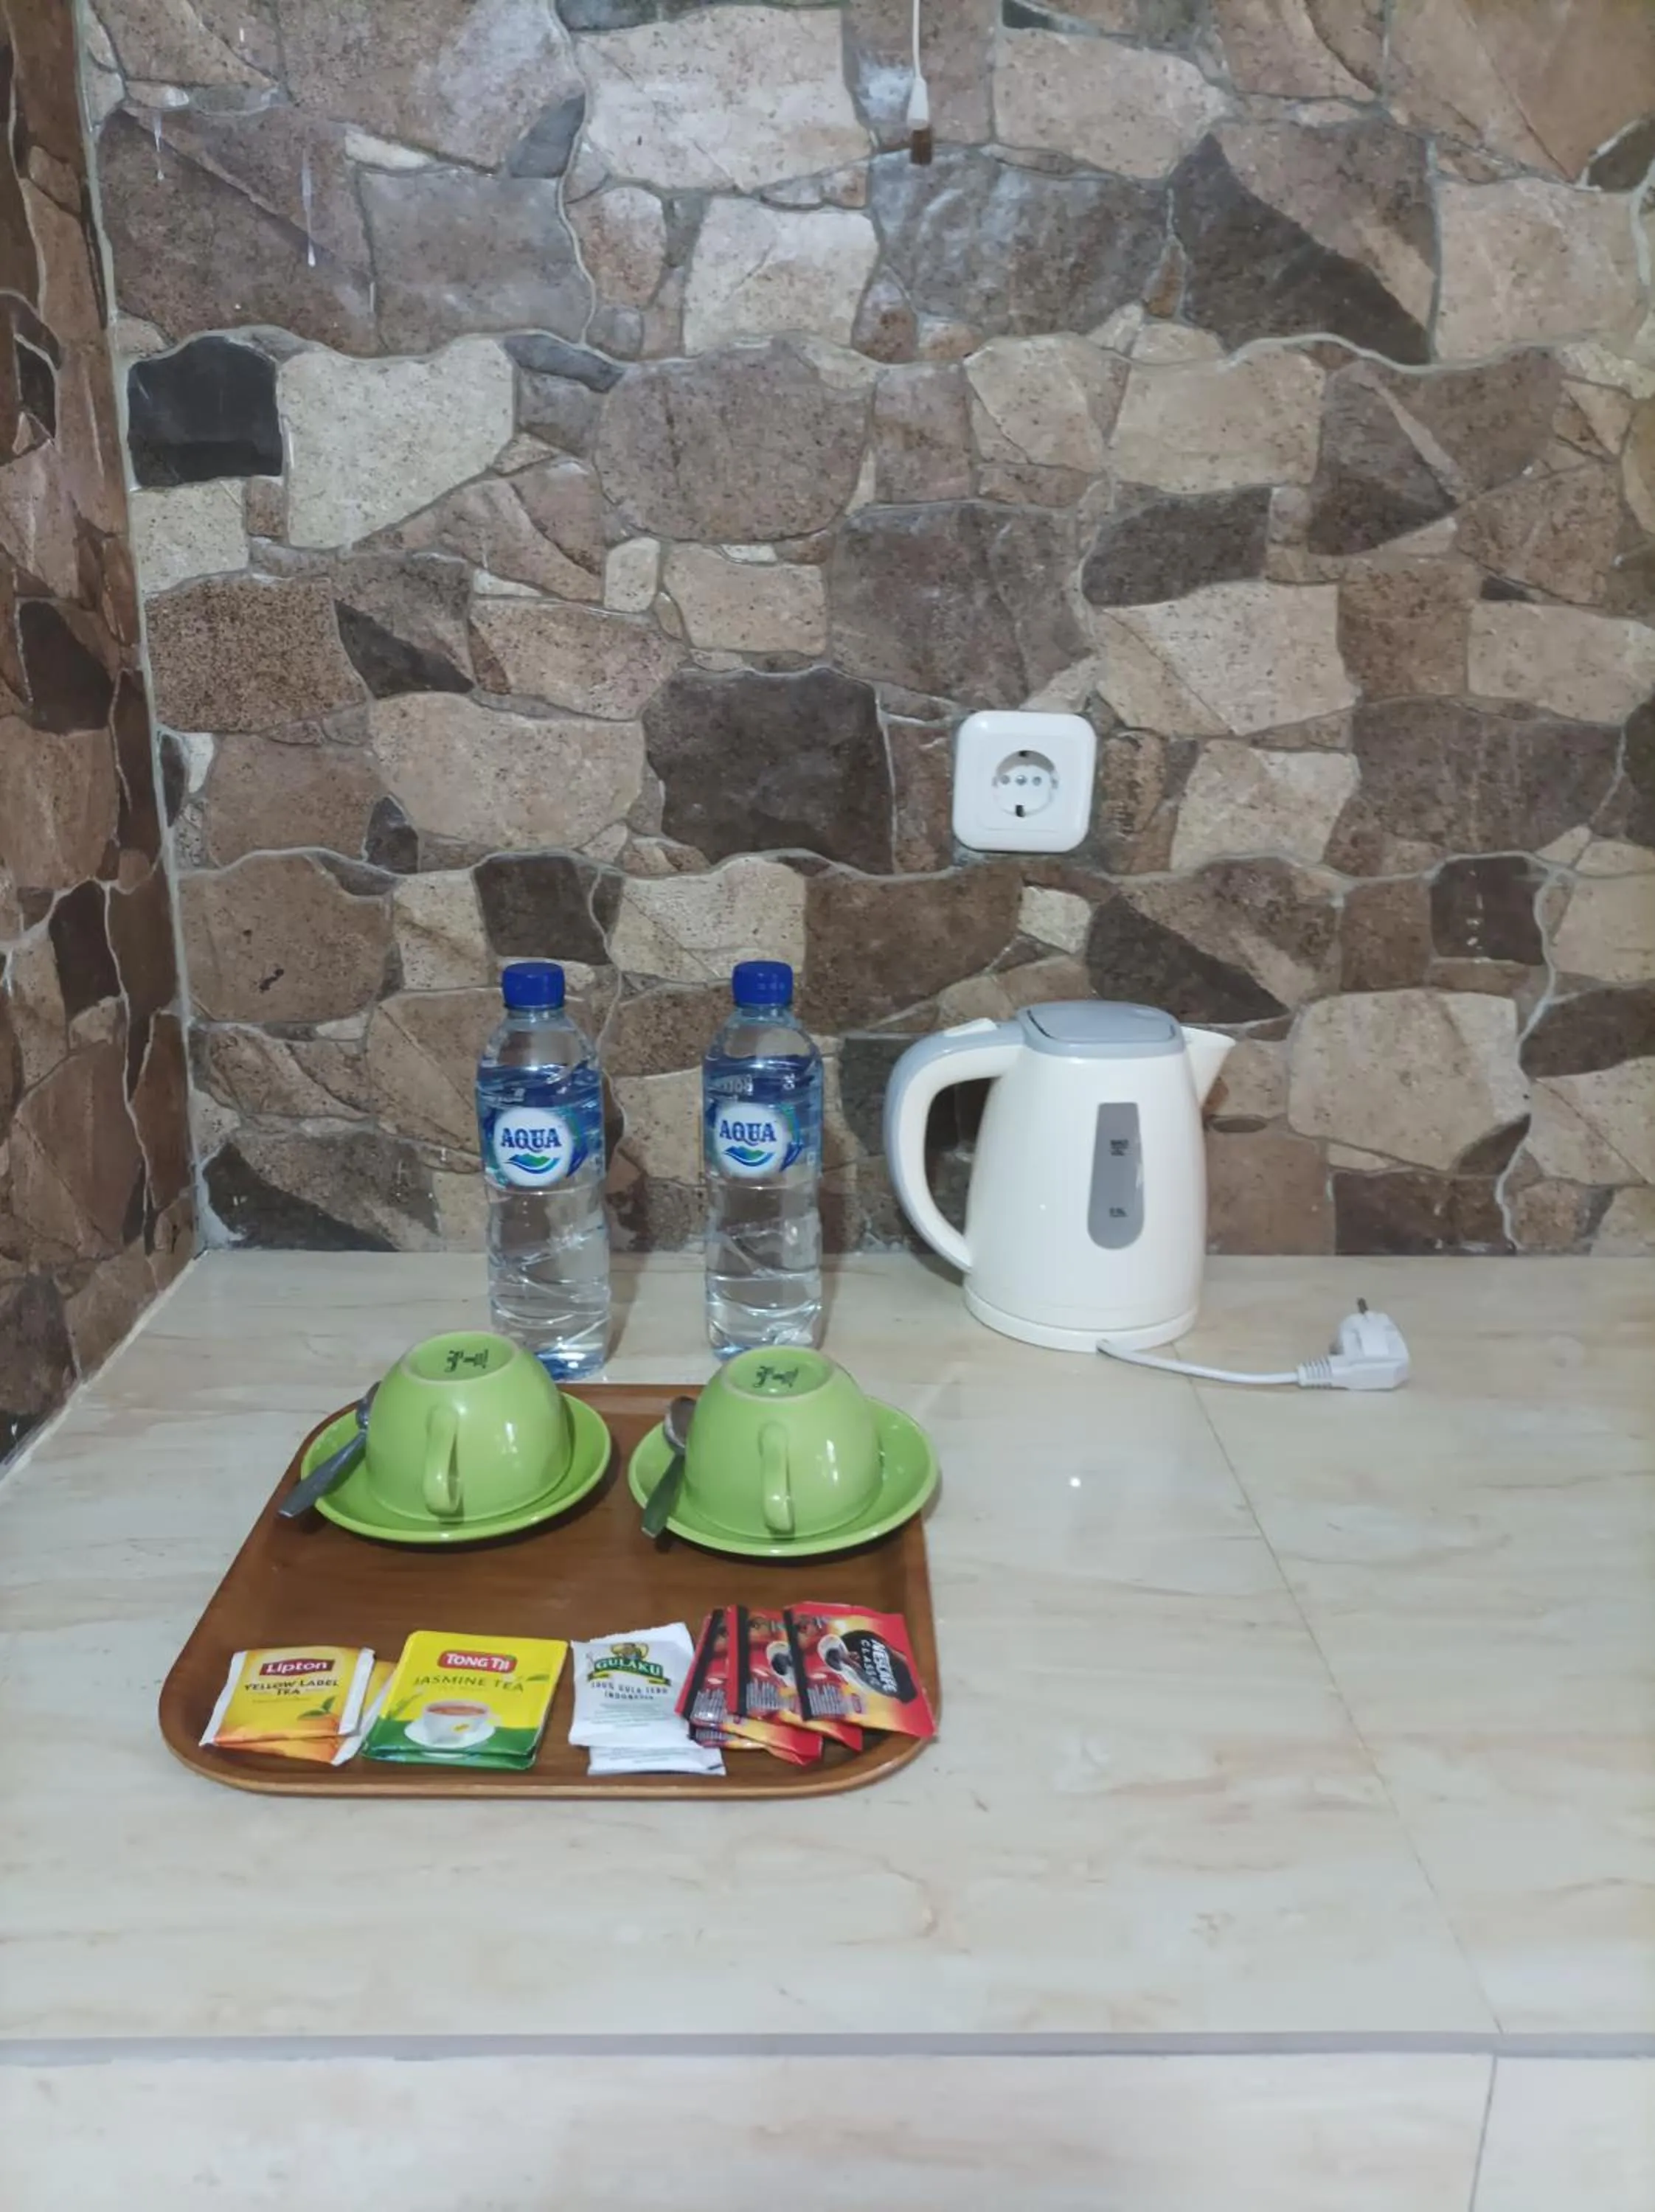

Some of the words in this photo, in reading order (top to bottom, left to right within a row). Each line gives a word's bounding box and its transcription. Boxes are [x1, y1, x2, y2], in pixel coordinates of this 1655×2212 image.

[501, 1127, 562, 1152] AQUA
[720, 1120, 777, 1147] AQUA
[266, 1660, 327, 1674] Lipton
[445, 1652, 488, 1668] TONG
[595, 1658, 662, 1677] GULAKU
[244, 1681, 296, 1691] YELLOW
[299, 1679, 340, 1688] LABEL
[277, 1688, 301, 1696] TEA
[414, 1674, 487, 1687] JASMINE
[494, 1678, 524, 1694] TEA
